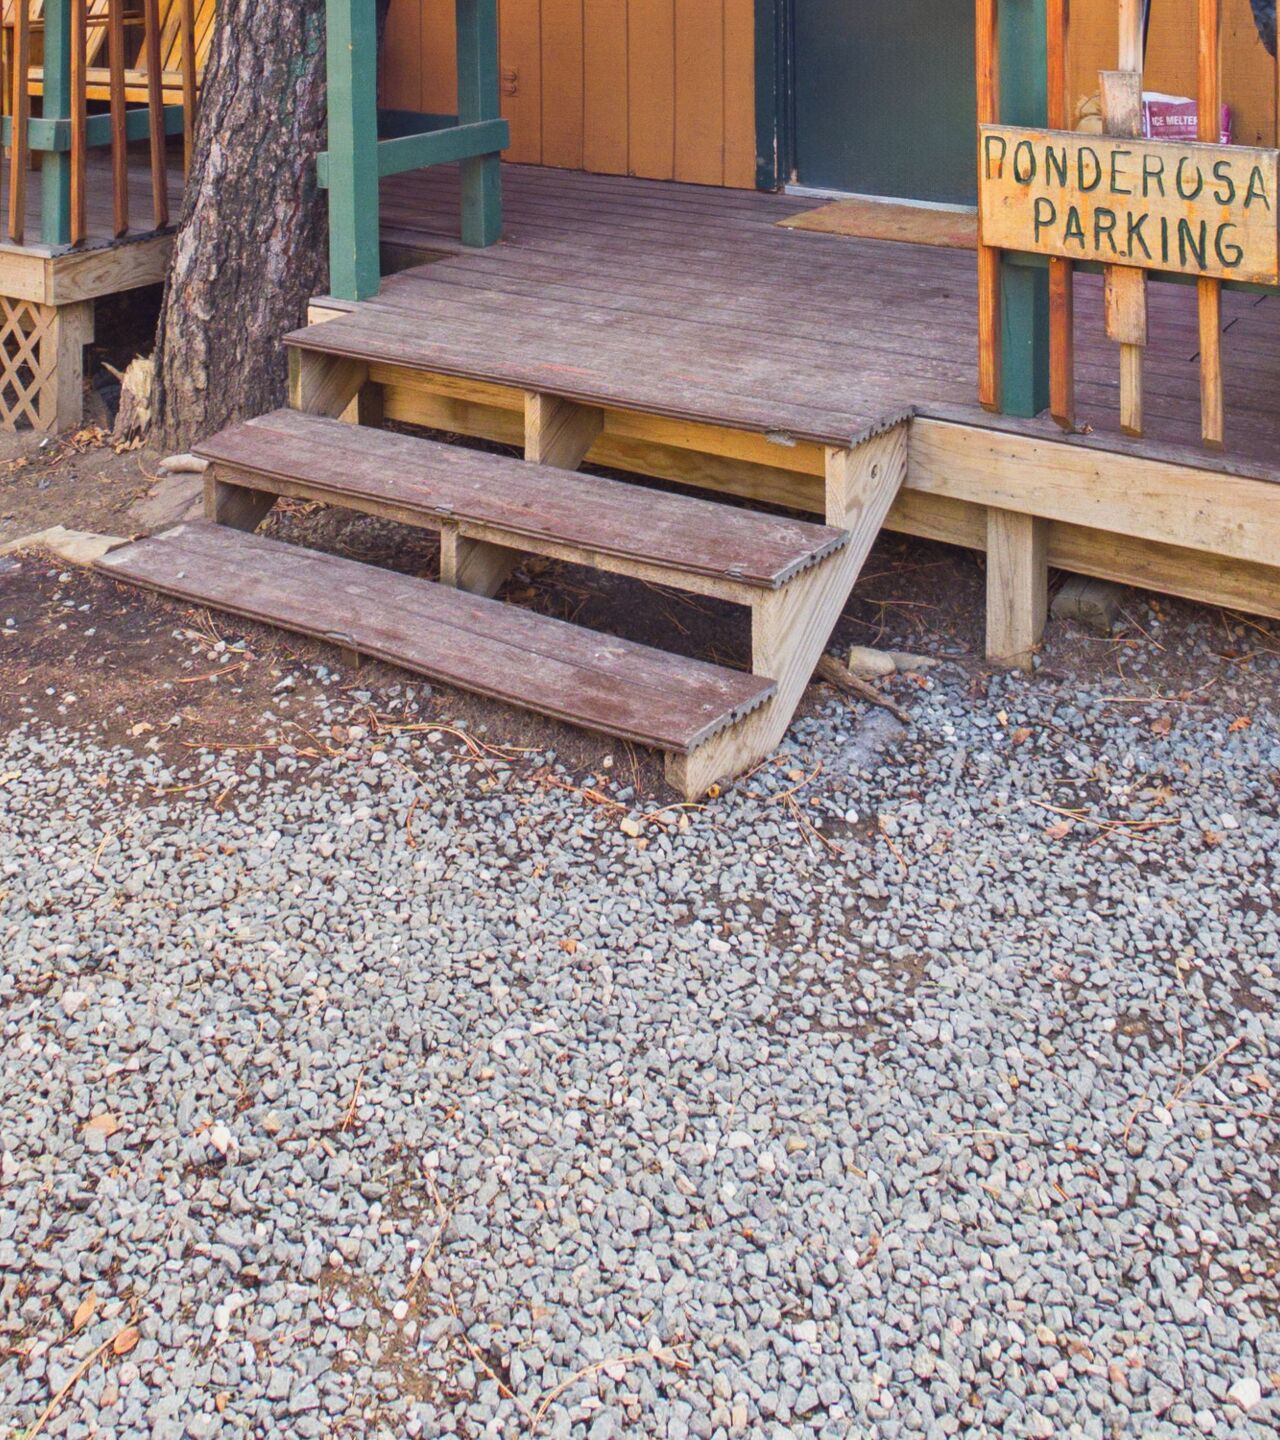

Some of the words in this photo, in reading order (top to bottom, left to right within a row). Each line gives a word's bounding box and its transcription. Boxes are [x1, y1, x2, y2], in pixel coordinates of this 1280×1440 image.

[1151, 116, 1165, 126] ICE
[984, 135, 1271, 211] PONDEROSA
[1033, 196, 1244, 270] PARKING
